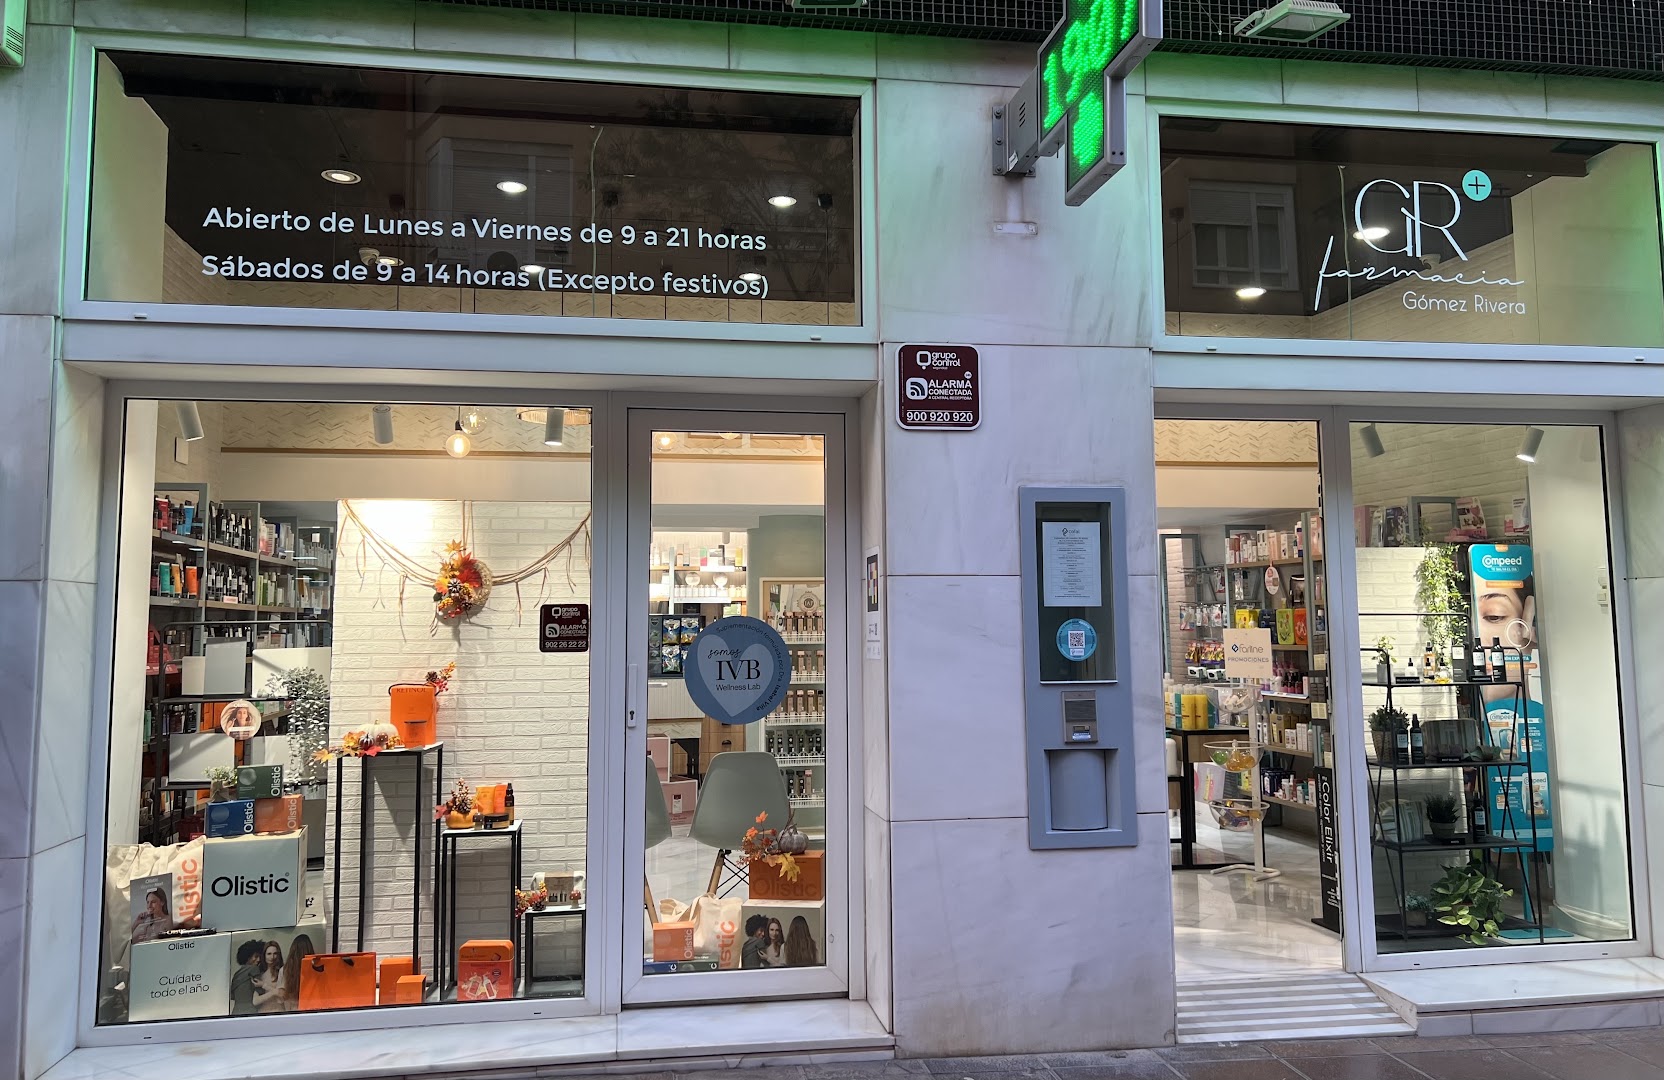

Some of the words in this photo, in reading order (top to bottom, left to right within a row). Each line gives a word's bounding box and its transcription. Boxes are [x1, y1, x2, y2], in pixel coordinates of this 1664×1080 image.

[202, 205, 312, 232] Abierto
[319, 211, 355, 234] de
[364, 212, 445, 238] Lunes
[450, 221, 466, 238] a
[471, 218, 573, 243] Viernes
[579, 222, 613, 244] de
[620, 225, 636, 245] 9
[643, 230, 658, 246] a
[662, 227, 689, 248] 21
[697, 227, 767, 251] horas
[1354, 178, 1469, 262] GR
[201, 252, 324, 280] Sábados
[332, 257, 368, 281] de
[376, 262, 392, 282] 9
[400, 266, 417, 283] a
[424, 263, 451, 285] 14
[456, 264, 531, 288] horas
[538, 268, 656, 296] (Excepto
[662, 271, 770, 299] festivos)
[1313, 235, 1526, 312] farmacia
[1402, 290, 1468, 312] Gómez
[1474, 294, 1526, 315] Rivera
[931, 358, 961, 367] control
[932, 352, 956, 360] grupo
[928, 379, 973, 389] ALARMA
[928, 388, 973, 396] CONECTADA
[906, 411, 927, 421] 900
[929, 411, 951, 422] 920
[952, 412, 974, 422] 920
[1481, 554, 1523, 569] Compeed
[707, 648, 742, 660] somos
[715, 659, 761, 681] IVB
[715, 683, 747, 692] Wellness
[747, 683, 761, 691] Lab
[270, 765, 281, 797] Olistic
[287, 798, 297, 829] Olistic
[1322, 781, 1332, 824] Color
[243, 801, 254, 833] Olistic
[1324, 826, 1334, 864] Elixir
[177, 858, 202, 918] listic
[211, 873, 290, 898] Olistic
[752, 876, 818, 898] Olistic
[167, 941, 195, 951] Olistic
[683, 928, 693, 960] Olistic
[150, 987, 177, 999] todo
[178, 985, 188, 995] el
[189, 983, 210, 994] año
[158, 973, 202, 986] Cuídate
